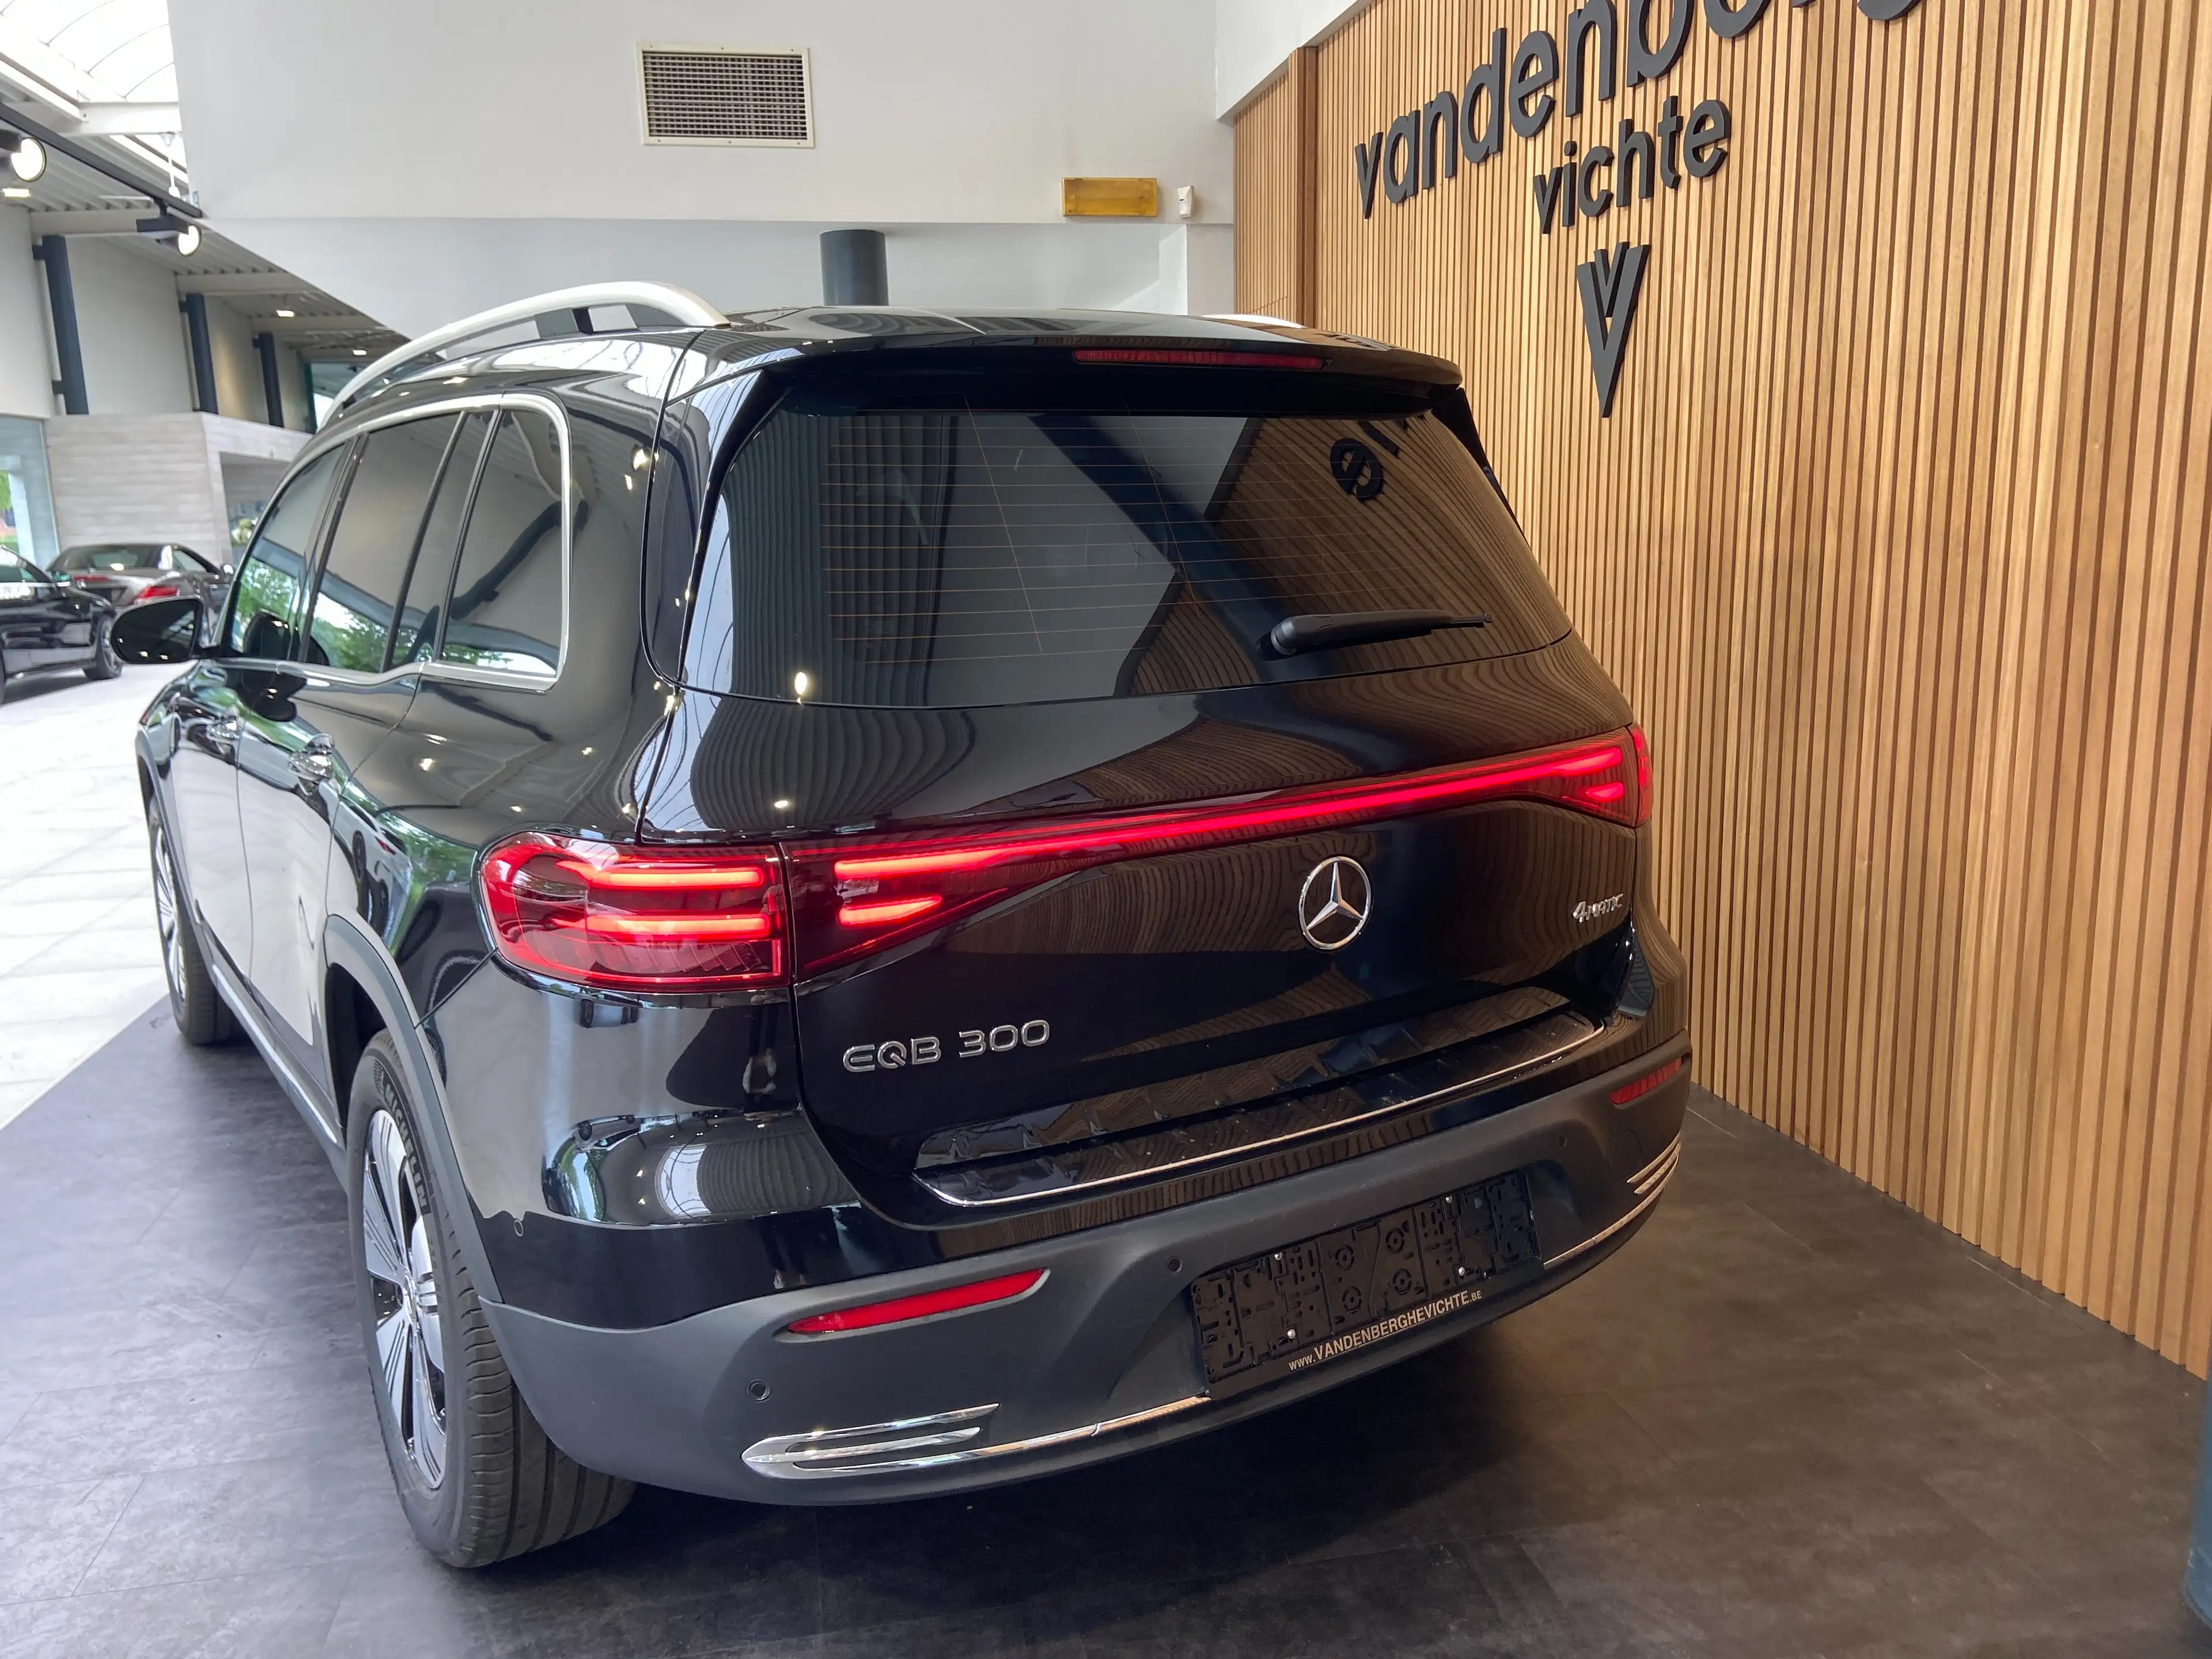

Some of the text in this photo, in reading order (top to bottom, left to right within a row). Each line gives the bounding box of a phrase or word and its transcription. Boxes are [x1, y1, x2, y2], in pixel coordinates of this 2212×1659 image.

[1355, 0, 1927, 218] vandenb
[1533, 96, 1730, 234] vichte
[843, 1019, 1050, 1073] EQB 300
[385, 1082, 428, 1209] MICHELIN
